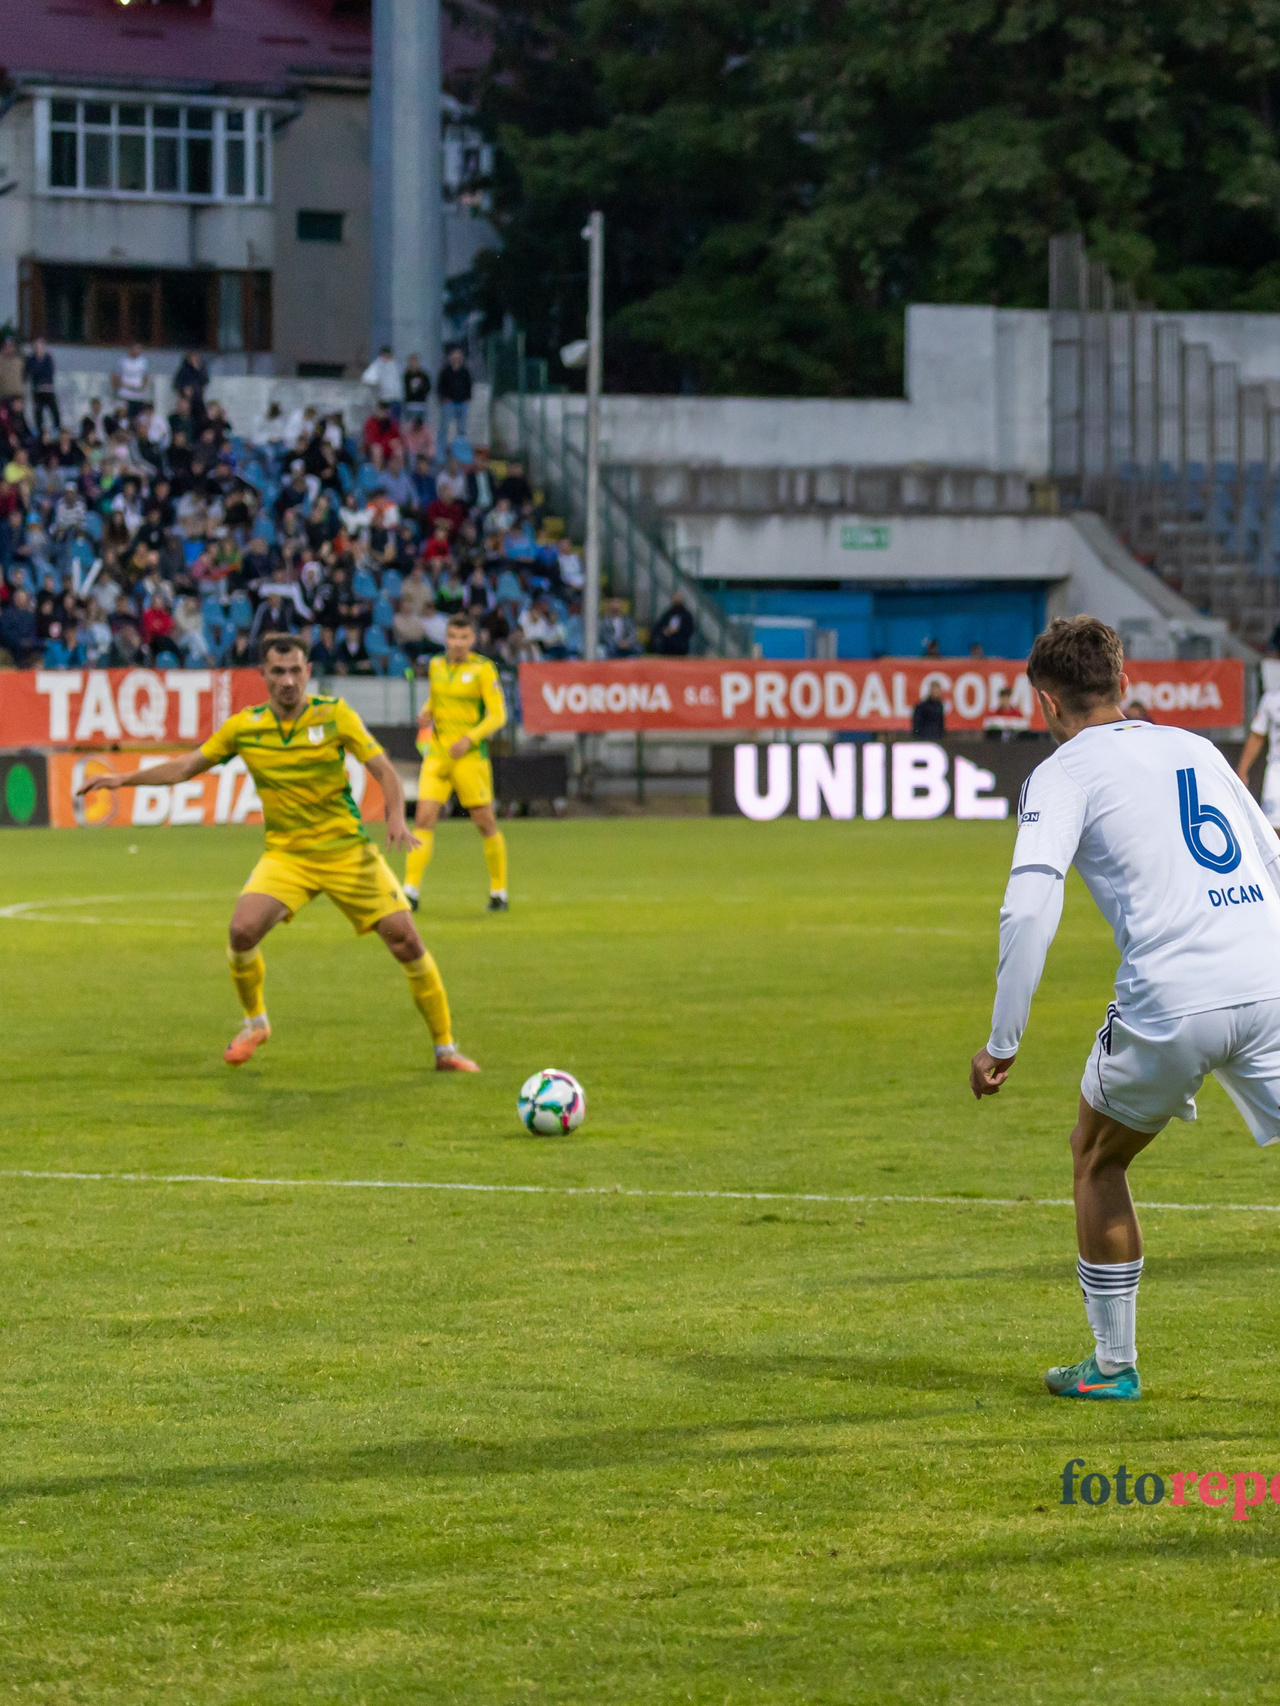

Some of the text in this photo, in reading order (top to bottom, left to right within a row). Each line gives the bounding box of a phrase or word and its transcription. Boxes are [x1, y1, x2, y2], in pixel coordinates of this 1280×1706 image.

[36, 671, 211, 741] TAQT
[542, 682, 672, 713] VORONA
[720, 671, 1035, 719] PRODALCOM
[1122, 681, 1223, 711] RONA
[1176, 767, 1242, 874] 6
[1208, 884, 1264, 907] DICAN
